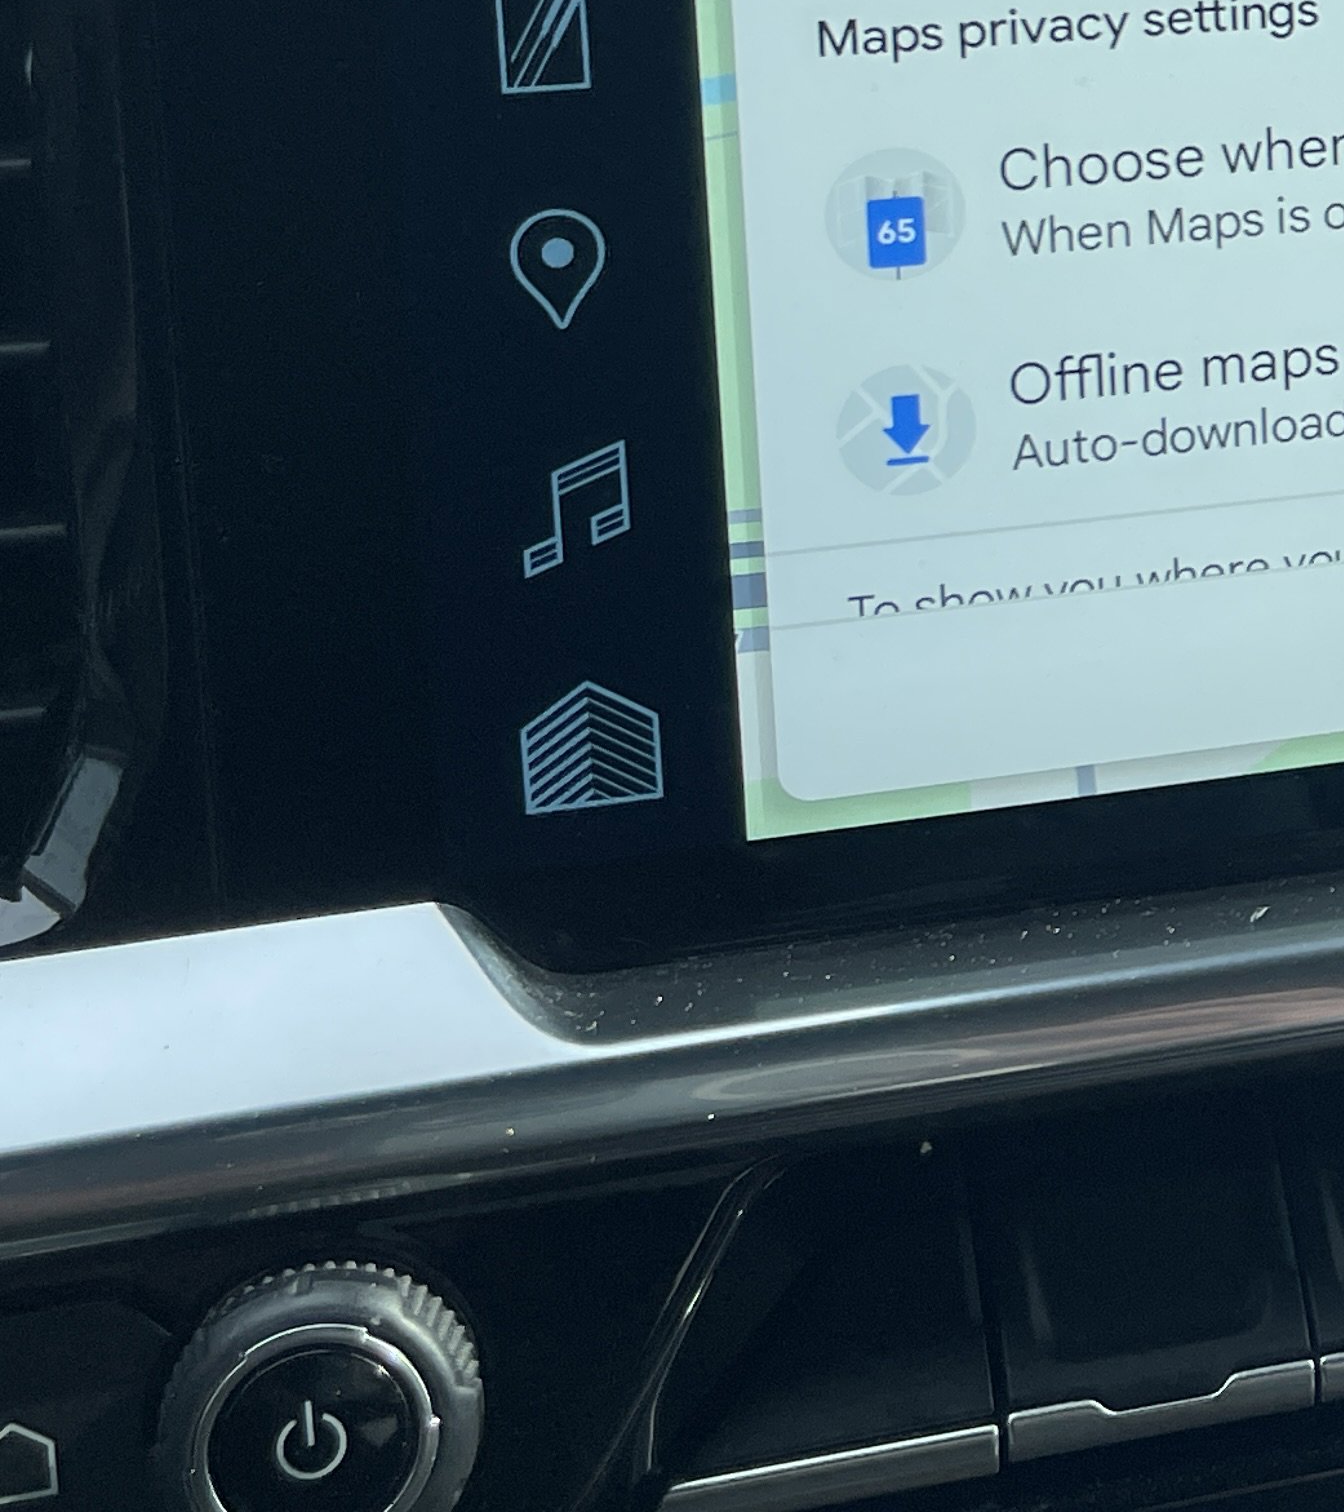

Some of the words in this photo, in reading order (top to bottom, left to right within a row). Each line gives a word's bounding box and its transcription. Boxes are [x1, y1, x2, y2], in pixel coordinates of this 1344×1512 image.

[818, 19, 942, 64] Maps
[959, 6, 1130, 58] privacy
[999, 143, 1204, 192] Choose
[878, 217, 917, 245] 65
[1001, 214, 1132, 258] When
[1148, 206, 1264, 250] Maps
[1277, 196, 1312, 236] is
[1010, 349, 1184, 407] Offline
[1202, 341, 1342, 391] maps
